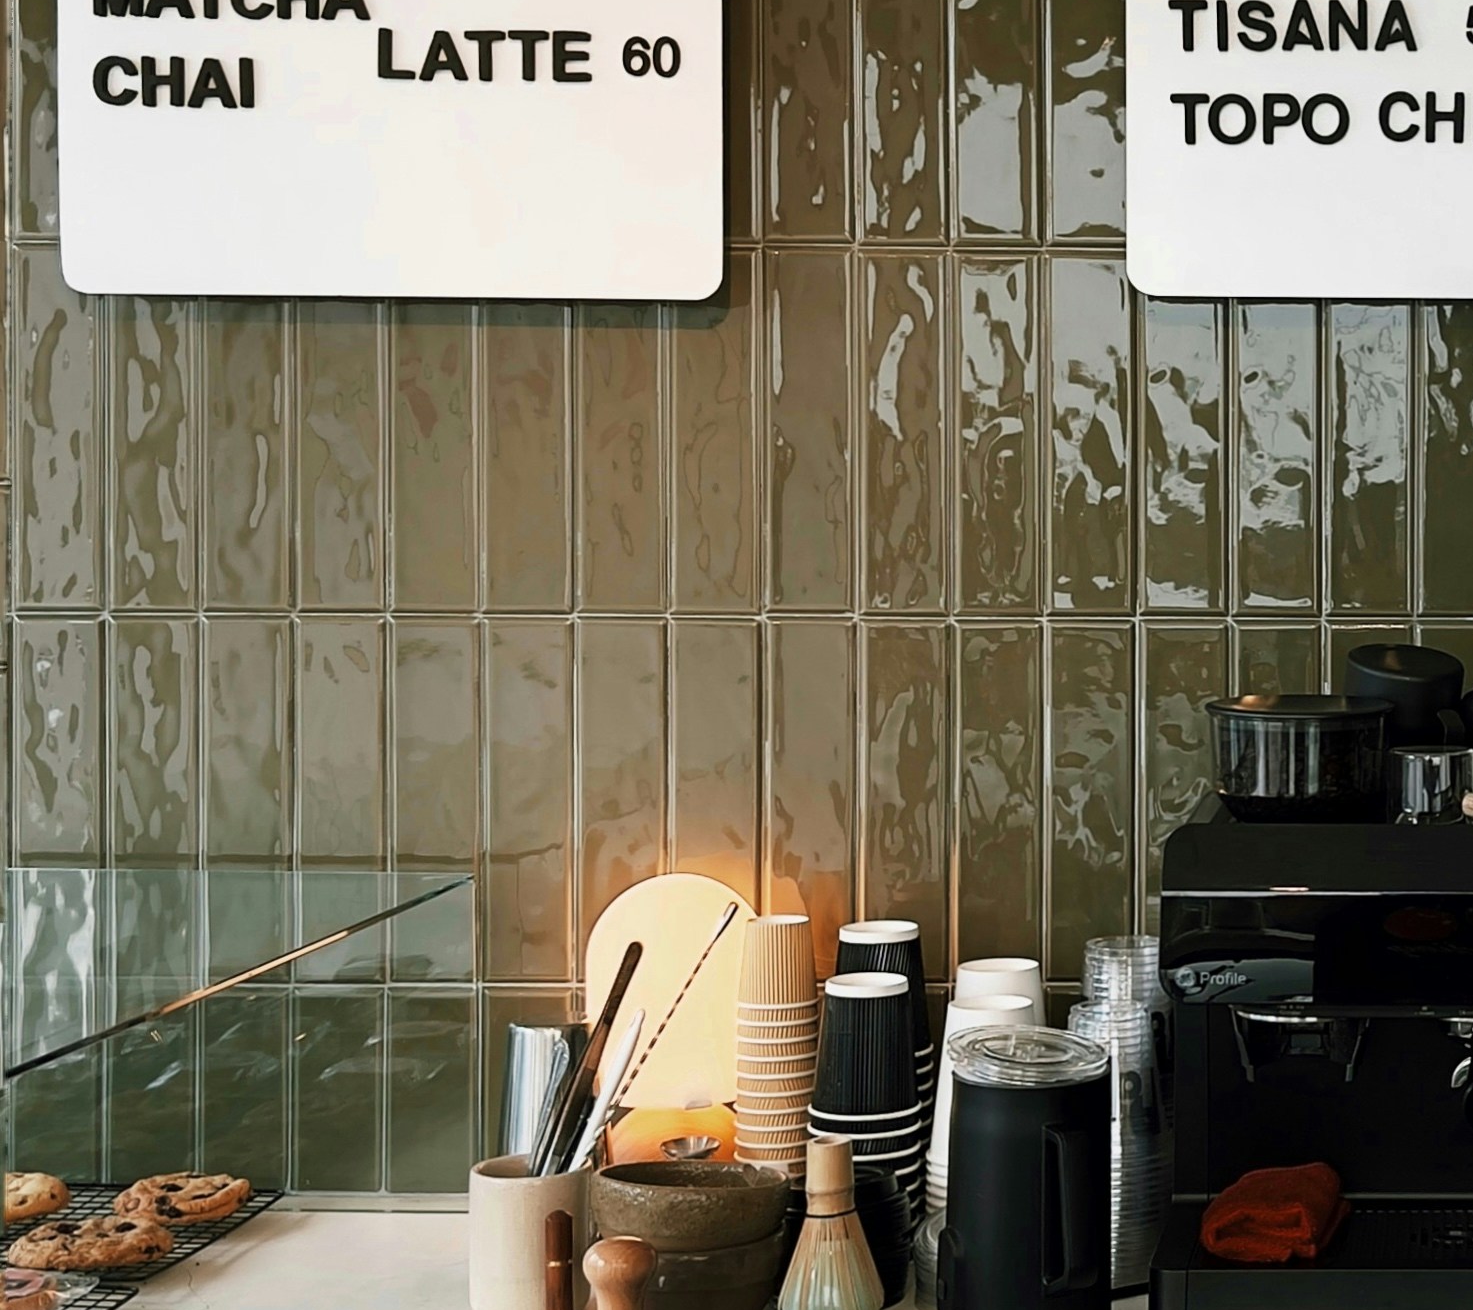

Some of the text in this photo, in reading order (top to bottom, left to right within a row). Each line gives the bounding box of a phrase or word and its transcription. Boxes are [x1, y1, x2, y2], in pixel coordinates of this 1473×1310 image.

[1168, 0, 1417, 52] TISANA
[378, 28, 680, 82] LATTE 60
[93, 56, 254, 108] CHAI
[1170, 93, 1349, 145] TOPO
[1199, 972, 1247, 986] Profile
